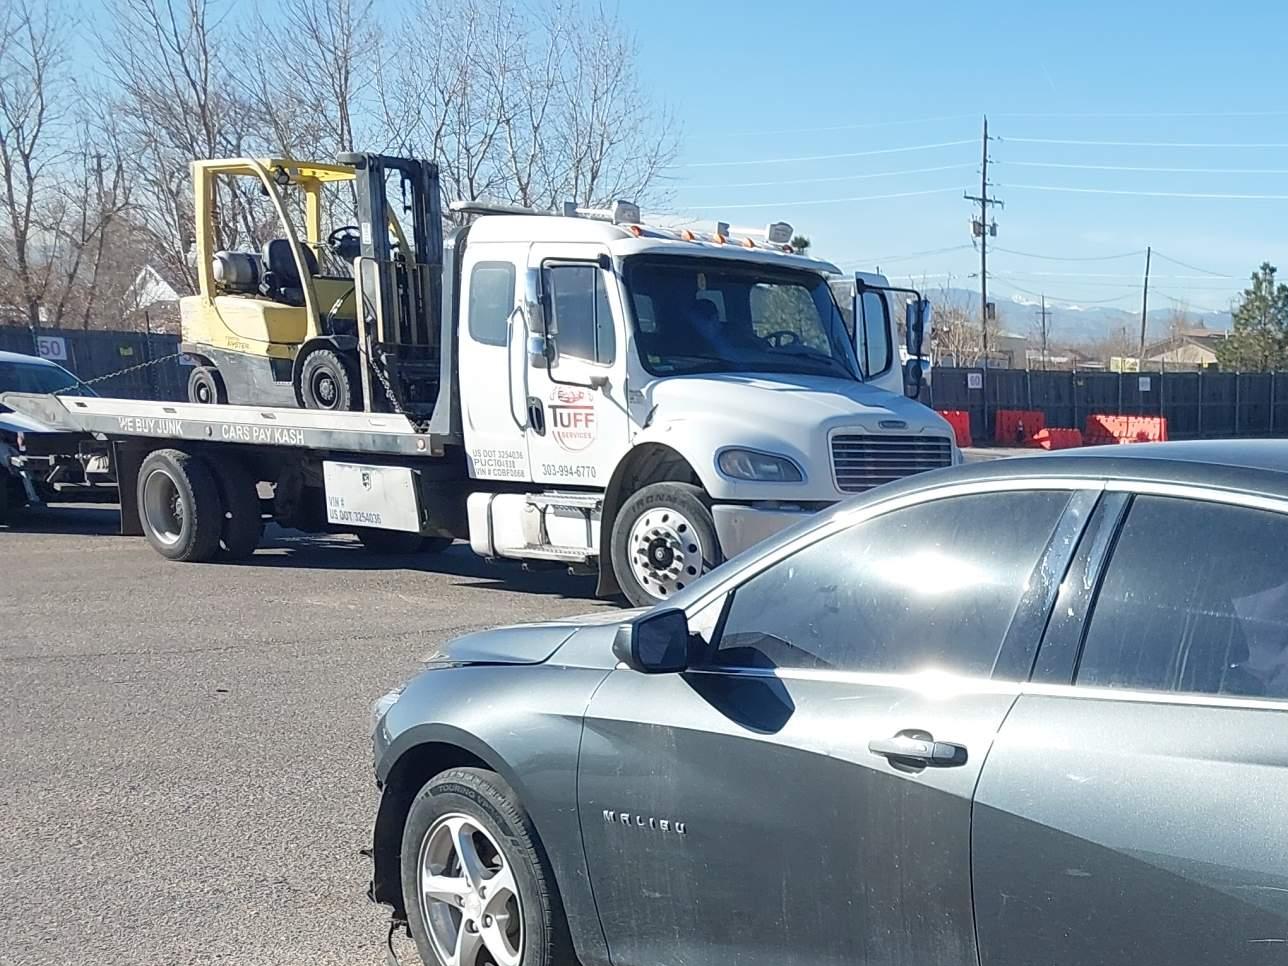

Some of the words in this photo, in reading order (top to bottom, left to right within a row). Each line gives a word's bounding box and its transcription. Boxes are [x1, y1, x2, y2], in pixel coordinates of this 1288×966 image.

[40, 340, 60, 355] 50
[548, 405, 594, 428] TUFF
[118, 416, 132, 431] WE
[136, 418, 154, 433] BUY
[157, 420, 183, 435] JUNK
[222, 425, 249, 440] CARS
[253, 427, 271, 442] PAY
[274, 429, 304, 444] KASH
[562, 431, 592, 439] SERVICES
[472, 449, 481, 458] US
[483, 449, 496, 459] DOT
[542, 464, 596, 478] 303-994-6770
[330, 509, 339, 519] US
[340, 510, 352, 521] DOT
[603, 810, 687, 834] MALIBU
